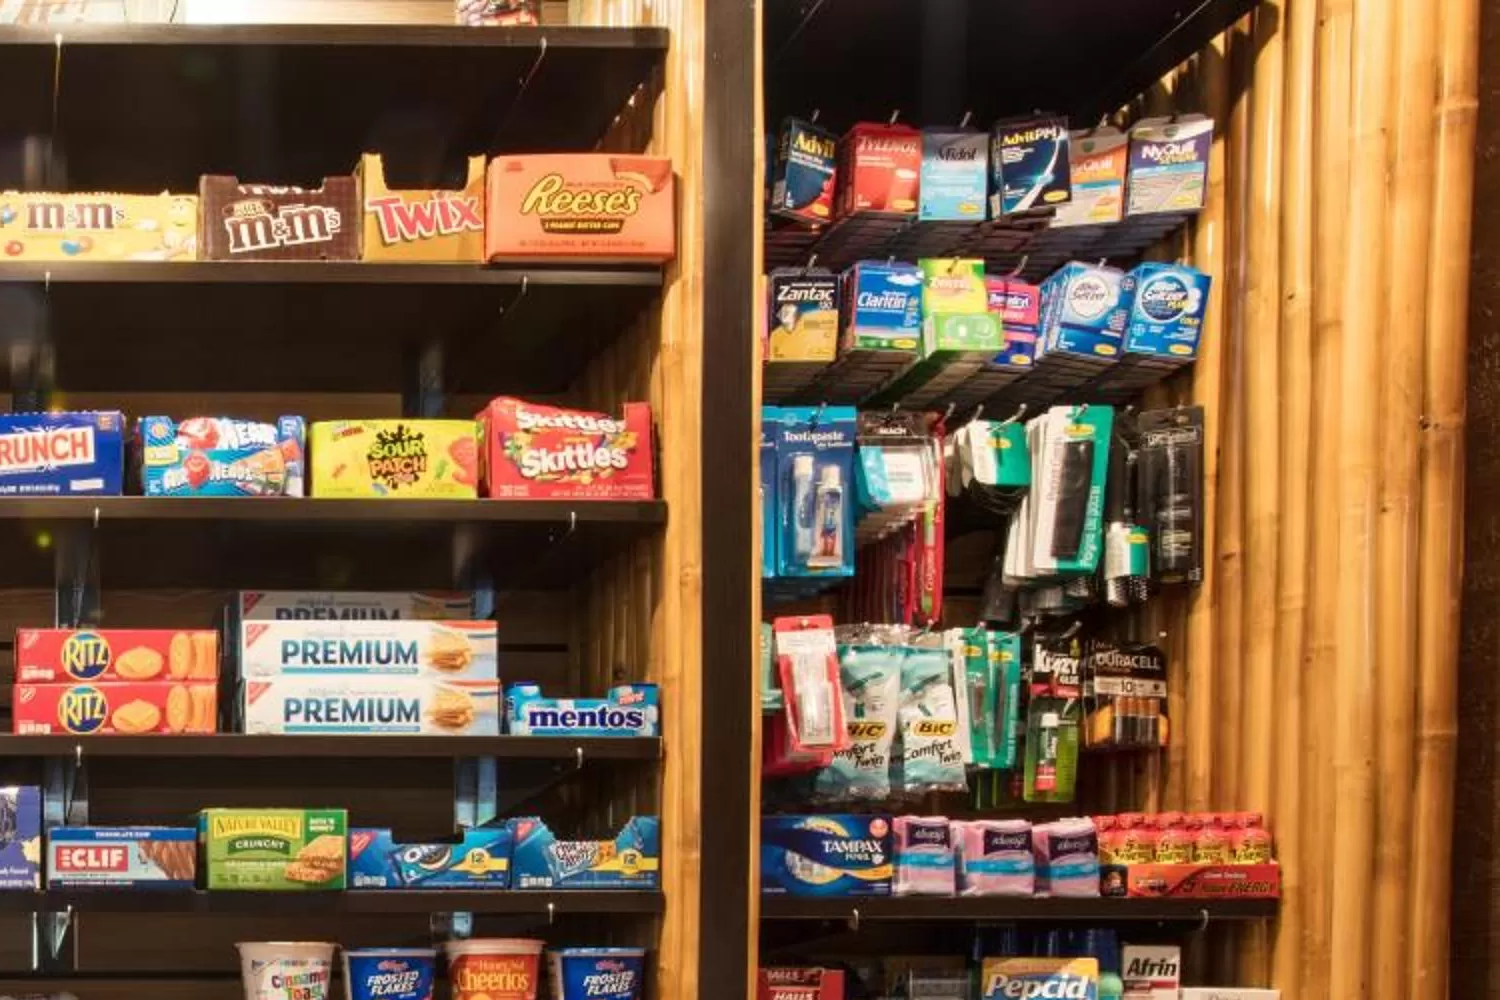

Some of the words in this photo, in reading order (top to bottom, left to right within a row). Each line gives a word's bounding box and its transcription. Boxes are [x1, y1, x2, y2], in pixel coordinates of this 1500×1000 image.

[778, 285, 835, 301] Zantac
[520, 443, 628, 478] Skittles
[281, 639, 419, 665] PREMIUM
[284, 697, 421, 723] PREMIUM
[528, 705, 644, 728] mentos
[1127, 957, 1177, 977] Afrin
